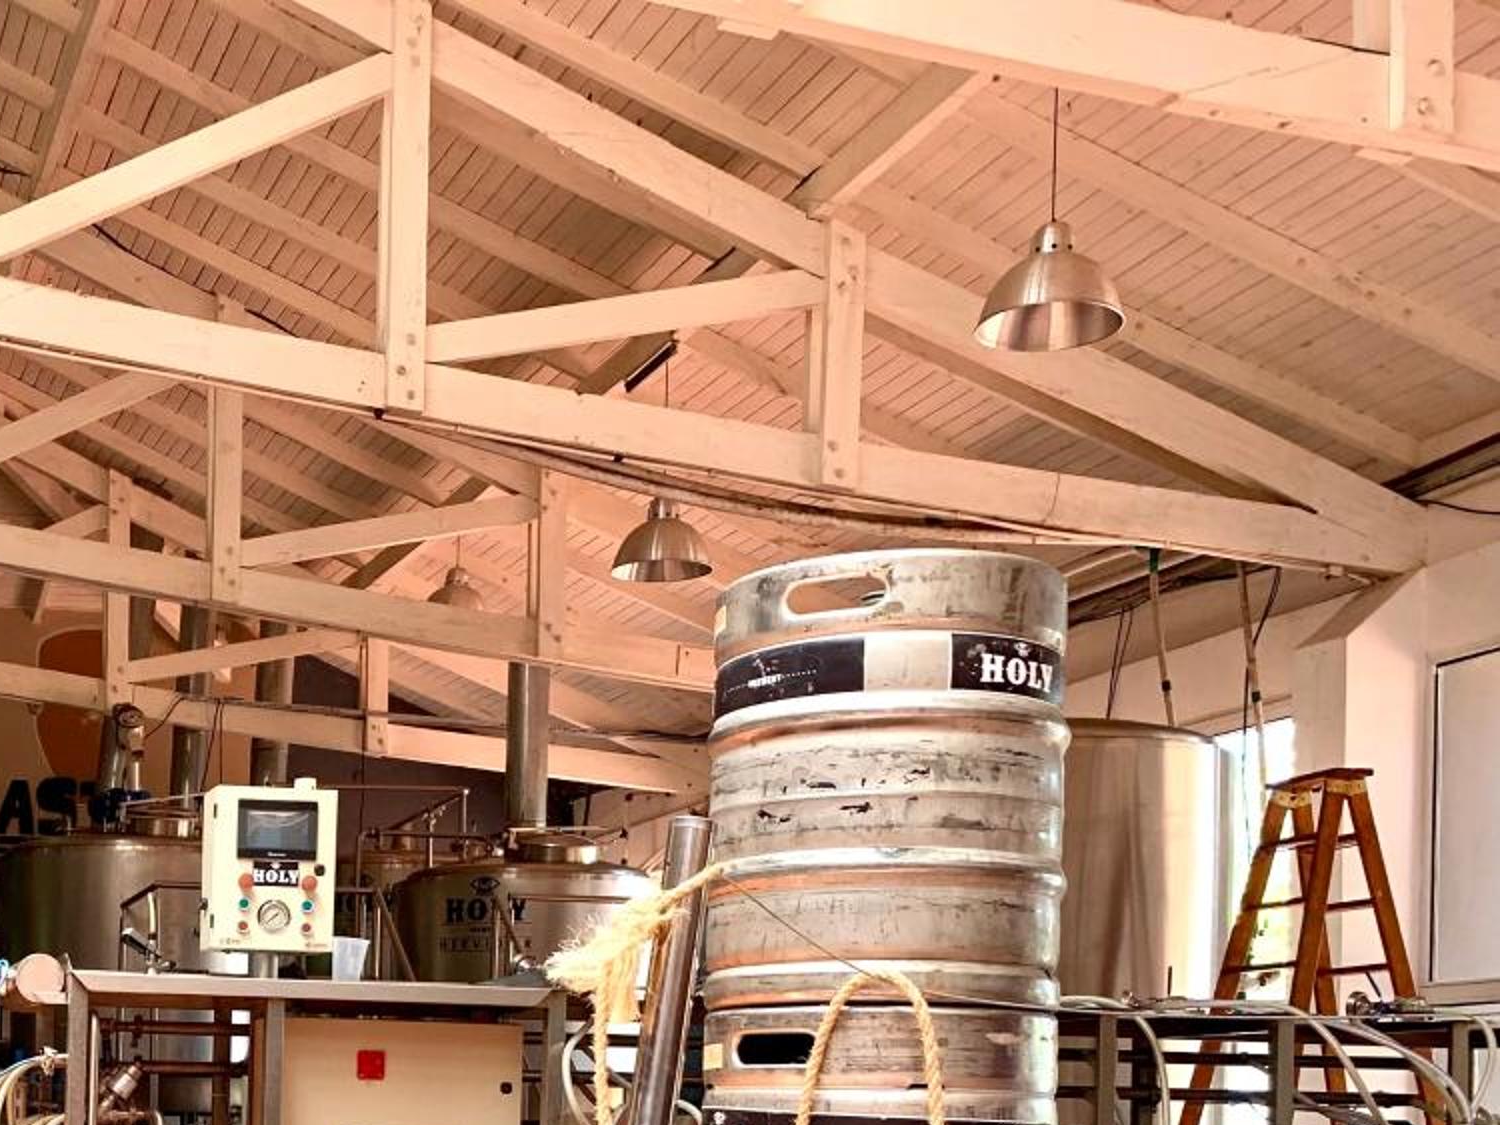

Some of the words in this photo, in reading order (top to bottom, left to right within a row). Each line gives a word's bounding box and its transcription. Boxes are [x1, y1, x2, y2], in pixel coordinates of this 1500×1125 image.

[980, 652, 1052, 694] HOLY
[253, 868, 300, 886] HOLY
[445, 896, 527, 922] HOY
